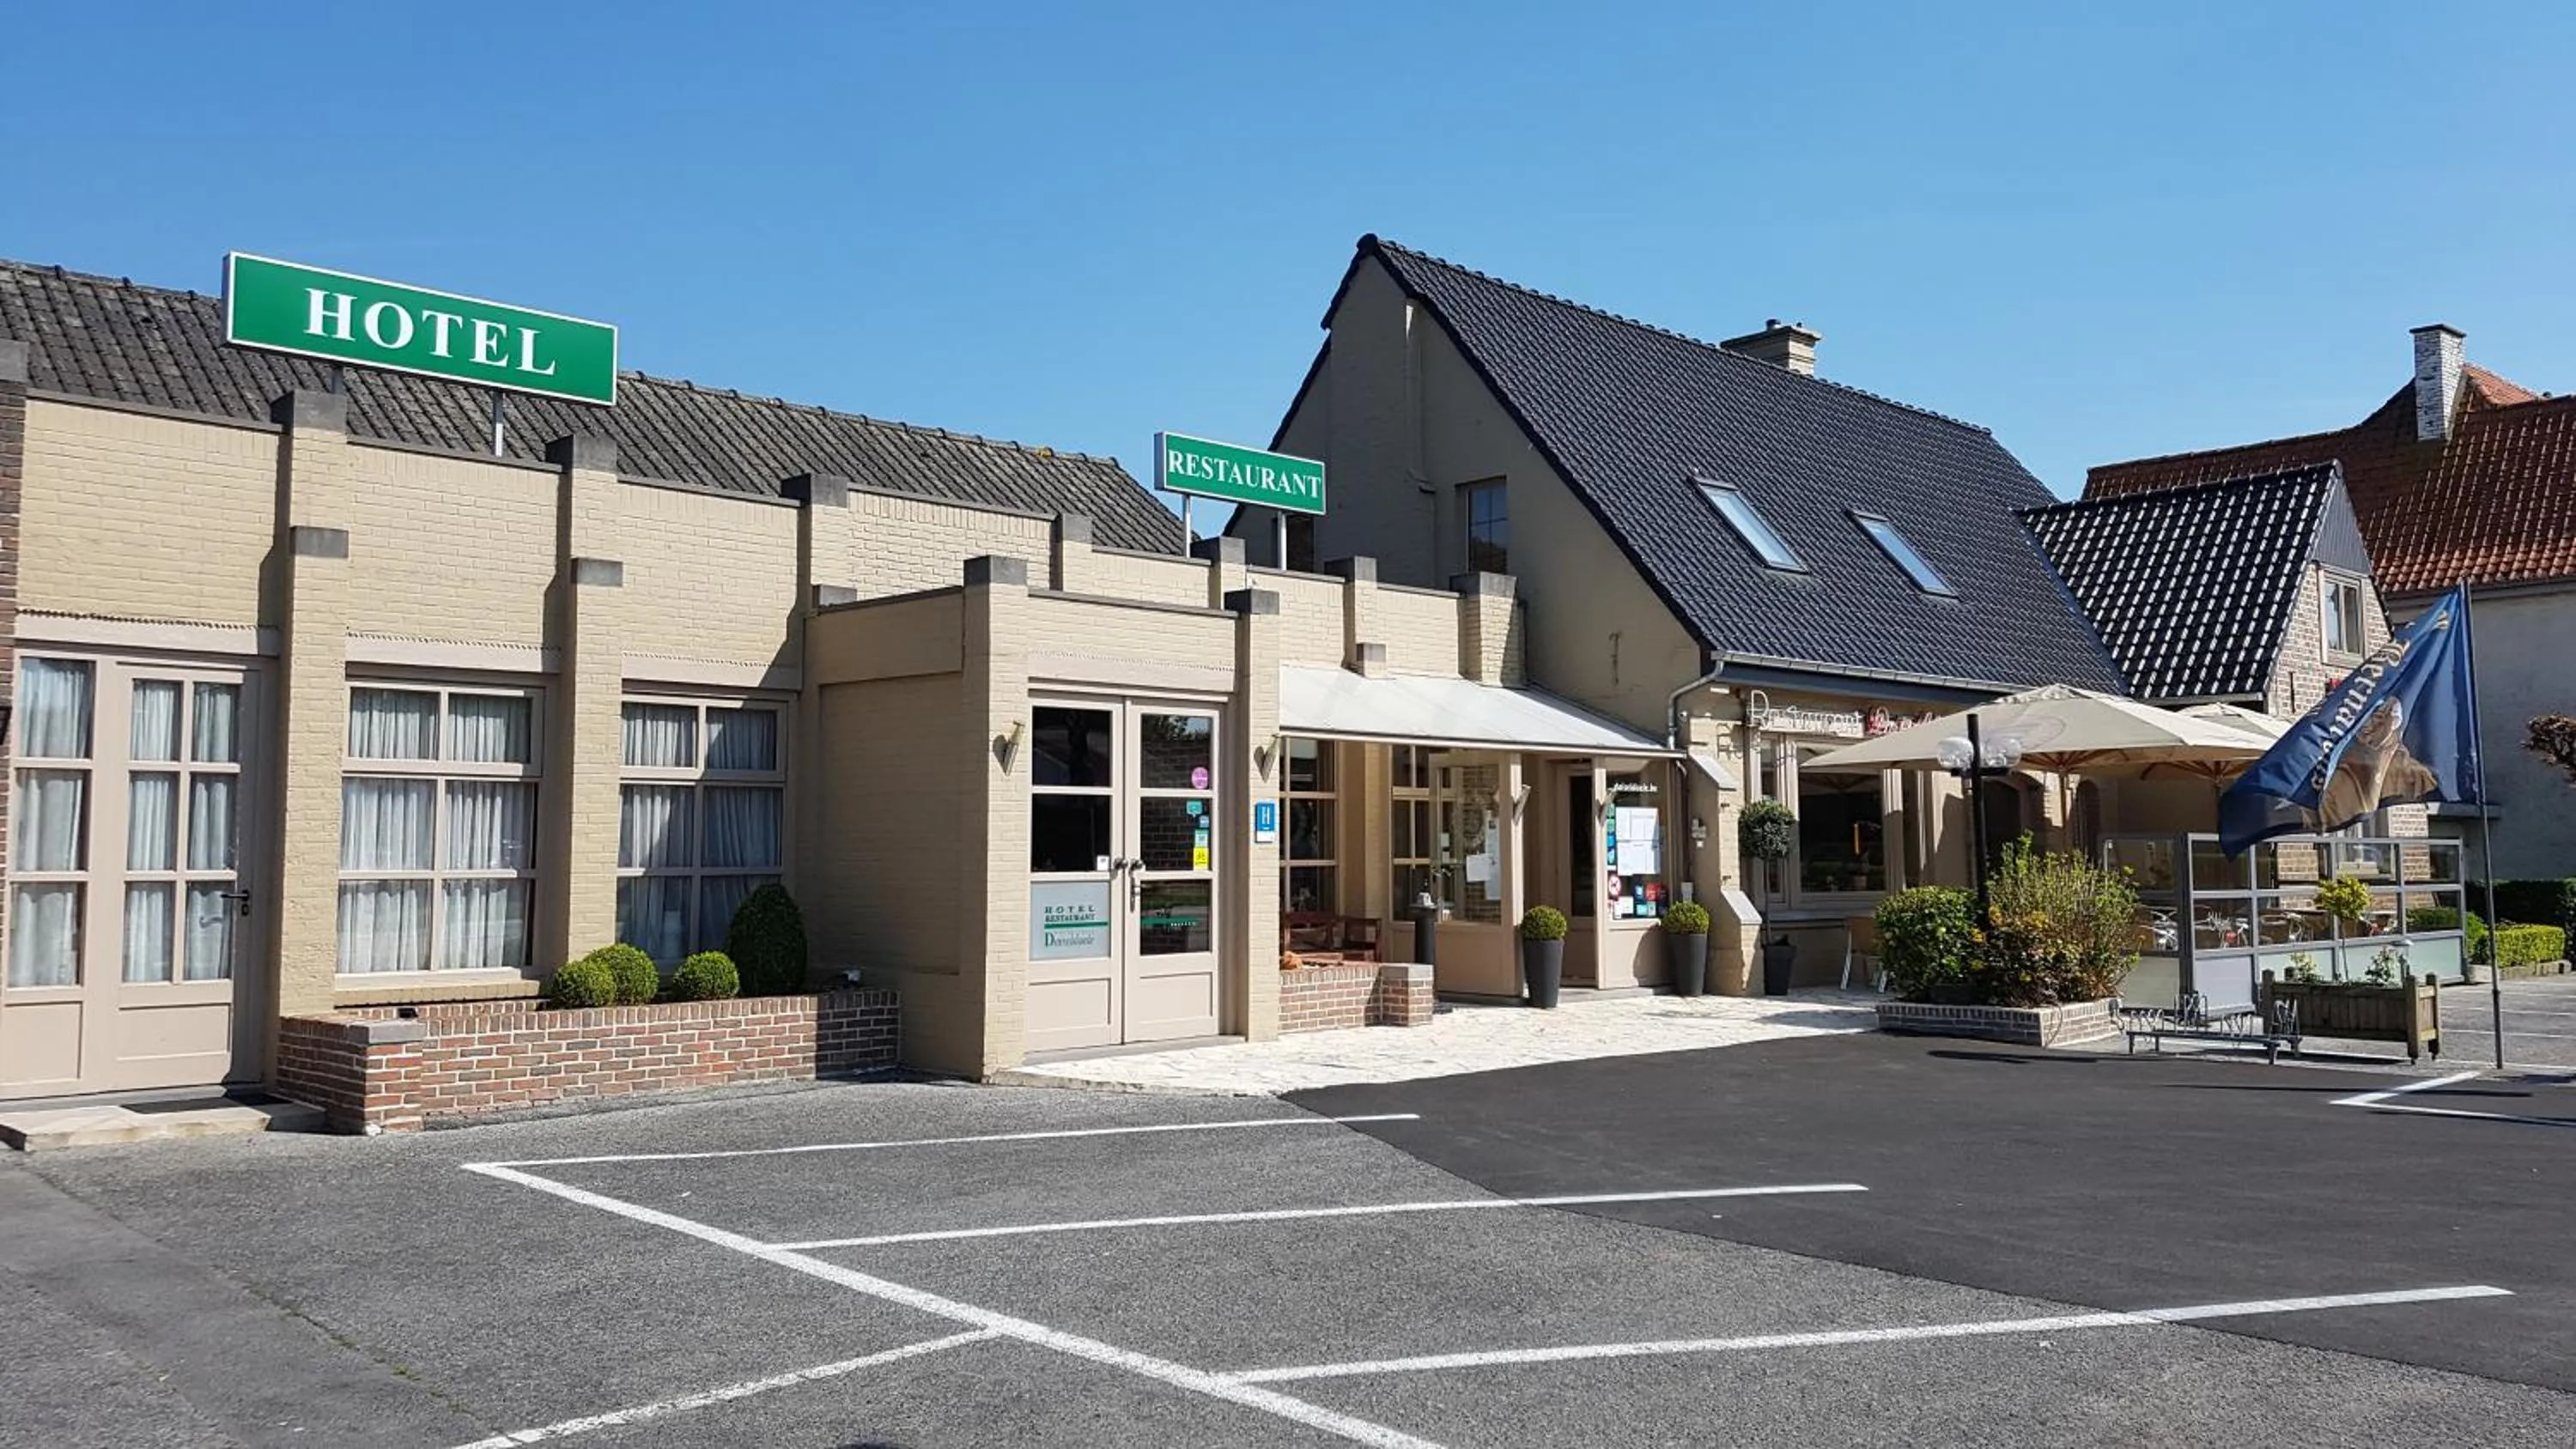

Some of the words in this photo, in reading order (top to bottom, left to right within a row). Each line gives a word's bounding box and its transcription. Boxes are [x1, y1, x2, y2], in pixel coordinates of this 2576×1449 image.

[303, 288, 556, 376] HOTEL
[1168, 449, 1321, 498] RESTAURANT
[1044, 906, 1096, 914] HOTEL
[1045, 913, 1096, 923] RESTAURANT
